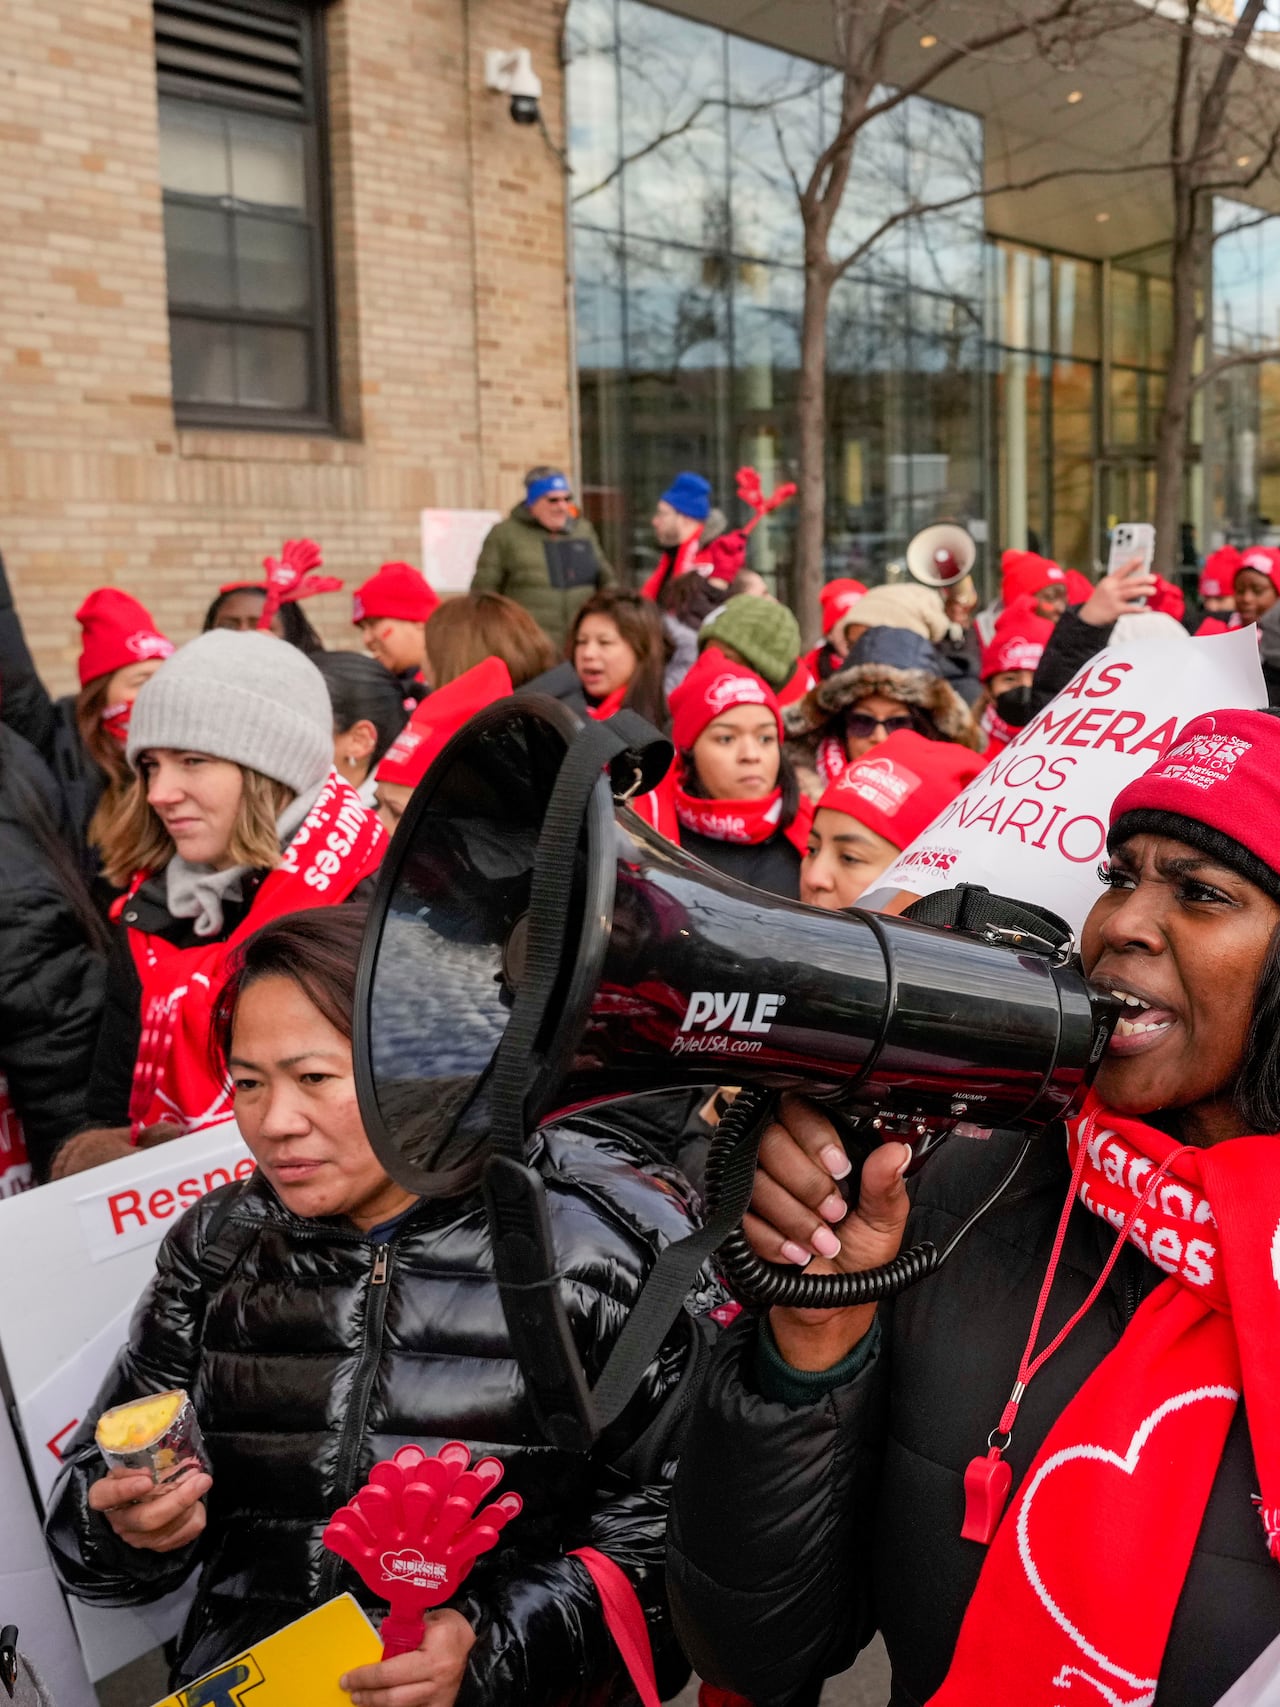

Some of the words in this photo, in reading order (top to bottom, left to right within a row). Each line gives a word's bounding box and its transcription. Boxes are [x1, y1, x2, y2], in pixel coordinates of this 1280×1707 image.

[1212, 733, 1228, 743] York
[1229, 736, 1252, 749] State
[973, 754, 1078, 791] NOS
[1184, 771, 1215, 785] Nurses
[1189, 765, 1230, 781] National
[680, 991, 780, 1033] PYLE
[670, 1036, 763, 1056] PyleUSA.com
[896, 1112, 909, 1120] OFF
[107, 1158, 259, 1236] Respe
[392, 1559, 447, 1577] NURSES
